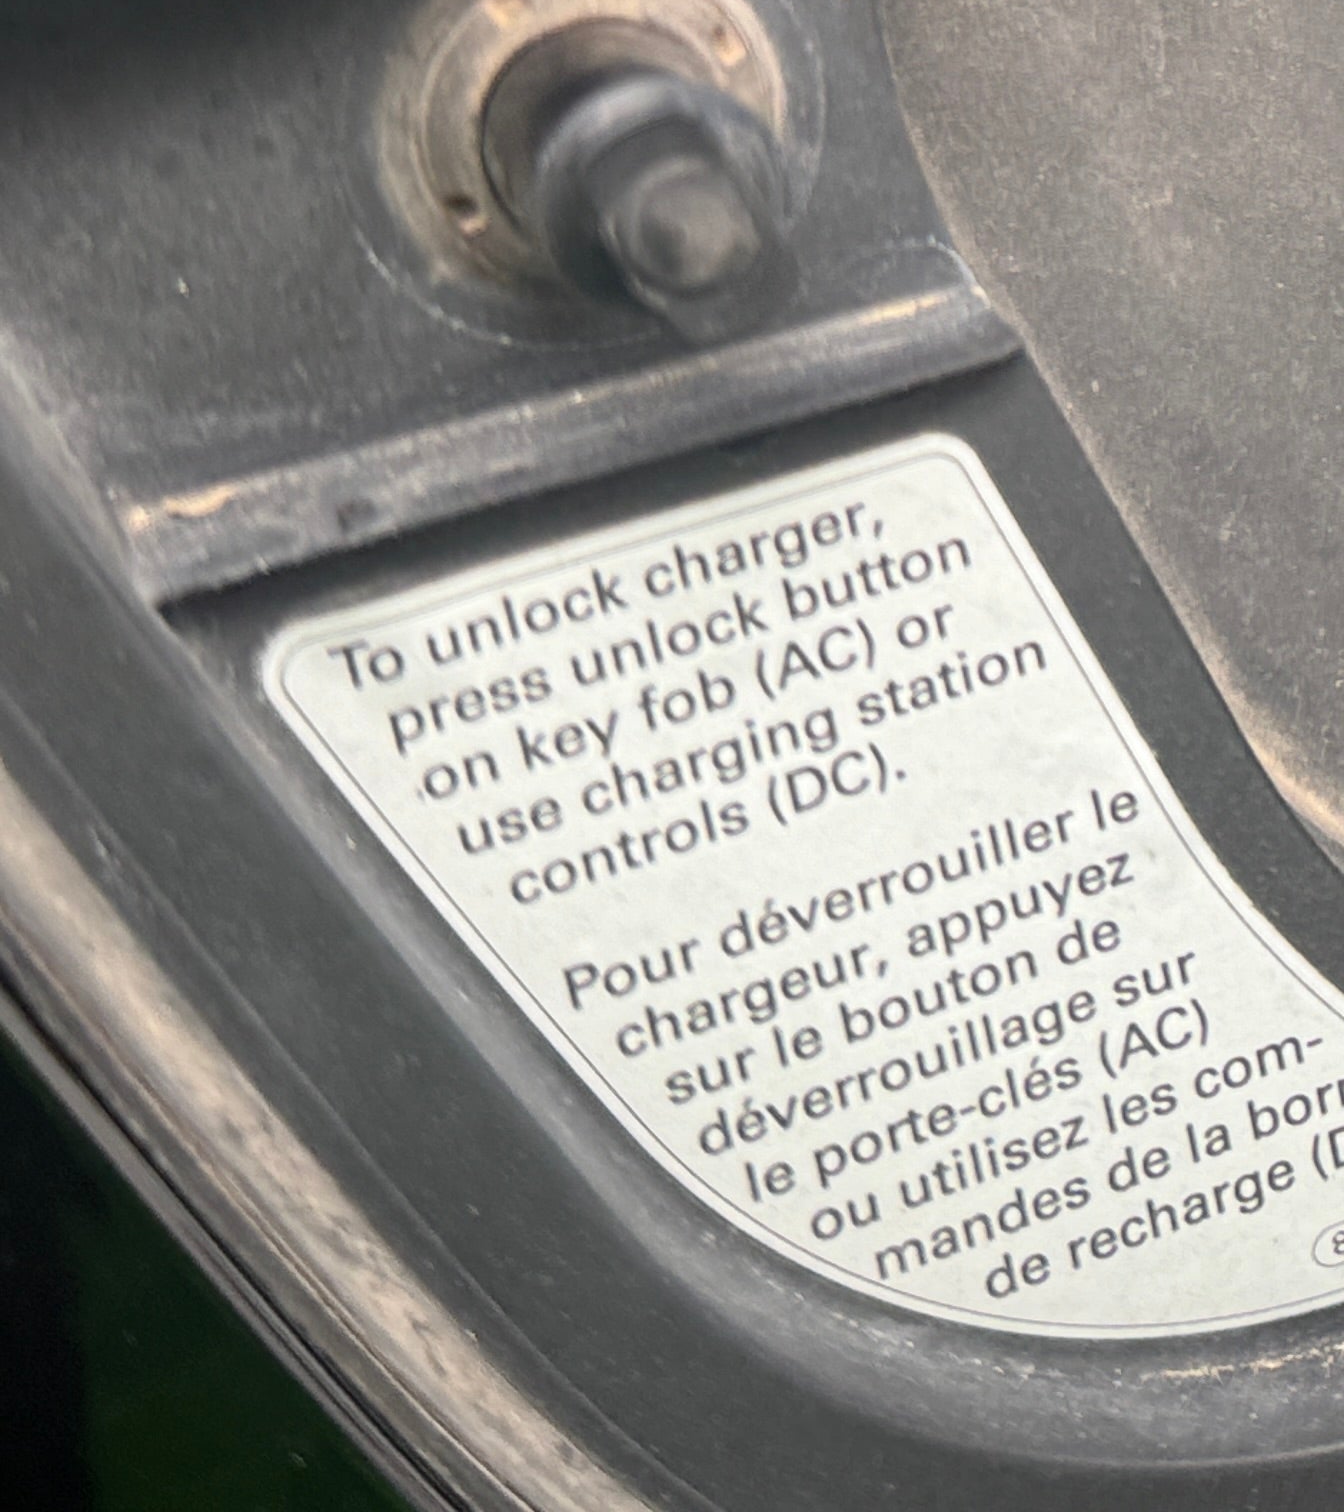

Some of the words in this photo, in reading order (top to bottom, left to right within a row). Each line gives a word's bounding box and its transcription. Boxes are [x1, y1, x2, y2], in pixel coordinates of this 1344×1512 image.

[328, 641, 404, 688] To
[427, 569, 627, 666] unlock
[644, 503, 882, 597] charger,
[389, 668, 552, 755] press
[571, 592, 768, 686] unlock
[782, 539, 971, 621] button
[423, 752, 500, 799] on
[516, 710, 618, 770] key
[638, 669, 736, 731] fob
[755, 618, 875, 700] (AC)
[897, 605, 952, 649] or
[457, 798, 562, 854] use
[582, 708, 838, 815] charging
[857, 642, 1046, 726] station
[510, 800, 749, 904] controls
[768, 743, 905, 826] (DC).
[563, 939, 698, 1010] Pour
[720, 810, 1073, 958] déverrouiller
[1091, 789, 1138, 831] le
[616, 944, 888, 1057] chargeur,
[908, 853, 1134, 957] appuyez
[666, 1048, 755, 1105] sur
[772, 1026, 822, 1067] le
[839, 951, 1038, 1044] bouton
[1057, 919, 1120, 965] de
[699, 991, 1096, 1156] déverrouillage
[1113, 952, 1195, 1007] sur
[744, 1162, 795, 1202] le
[813, 1056, 1082, 1189] porte-clés
[1099, 999, 1208, 1079] (AC)
[811, 1193, 880, 1240] ou
[900, 1116, 1088, 1208] utilisez
[1102, 1084, 1177, 1134] les
[1194, 1037, 1322, 1099] com-
[875, 1177, 1091, 1280] mandes
[1108, 1146, 1171, 1192] de
[1186, 1123, 1232, 1163] la
[986, 1252, 1050, 1298] de
[1068, 1160, 1295, 1269] recharge
